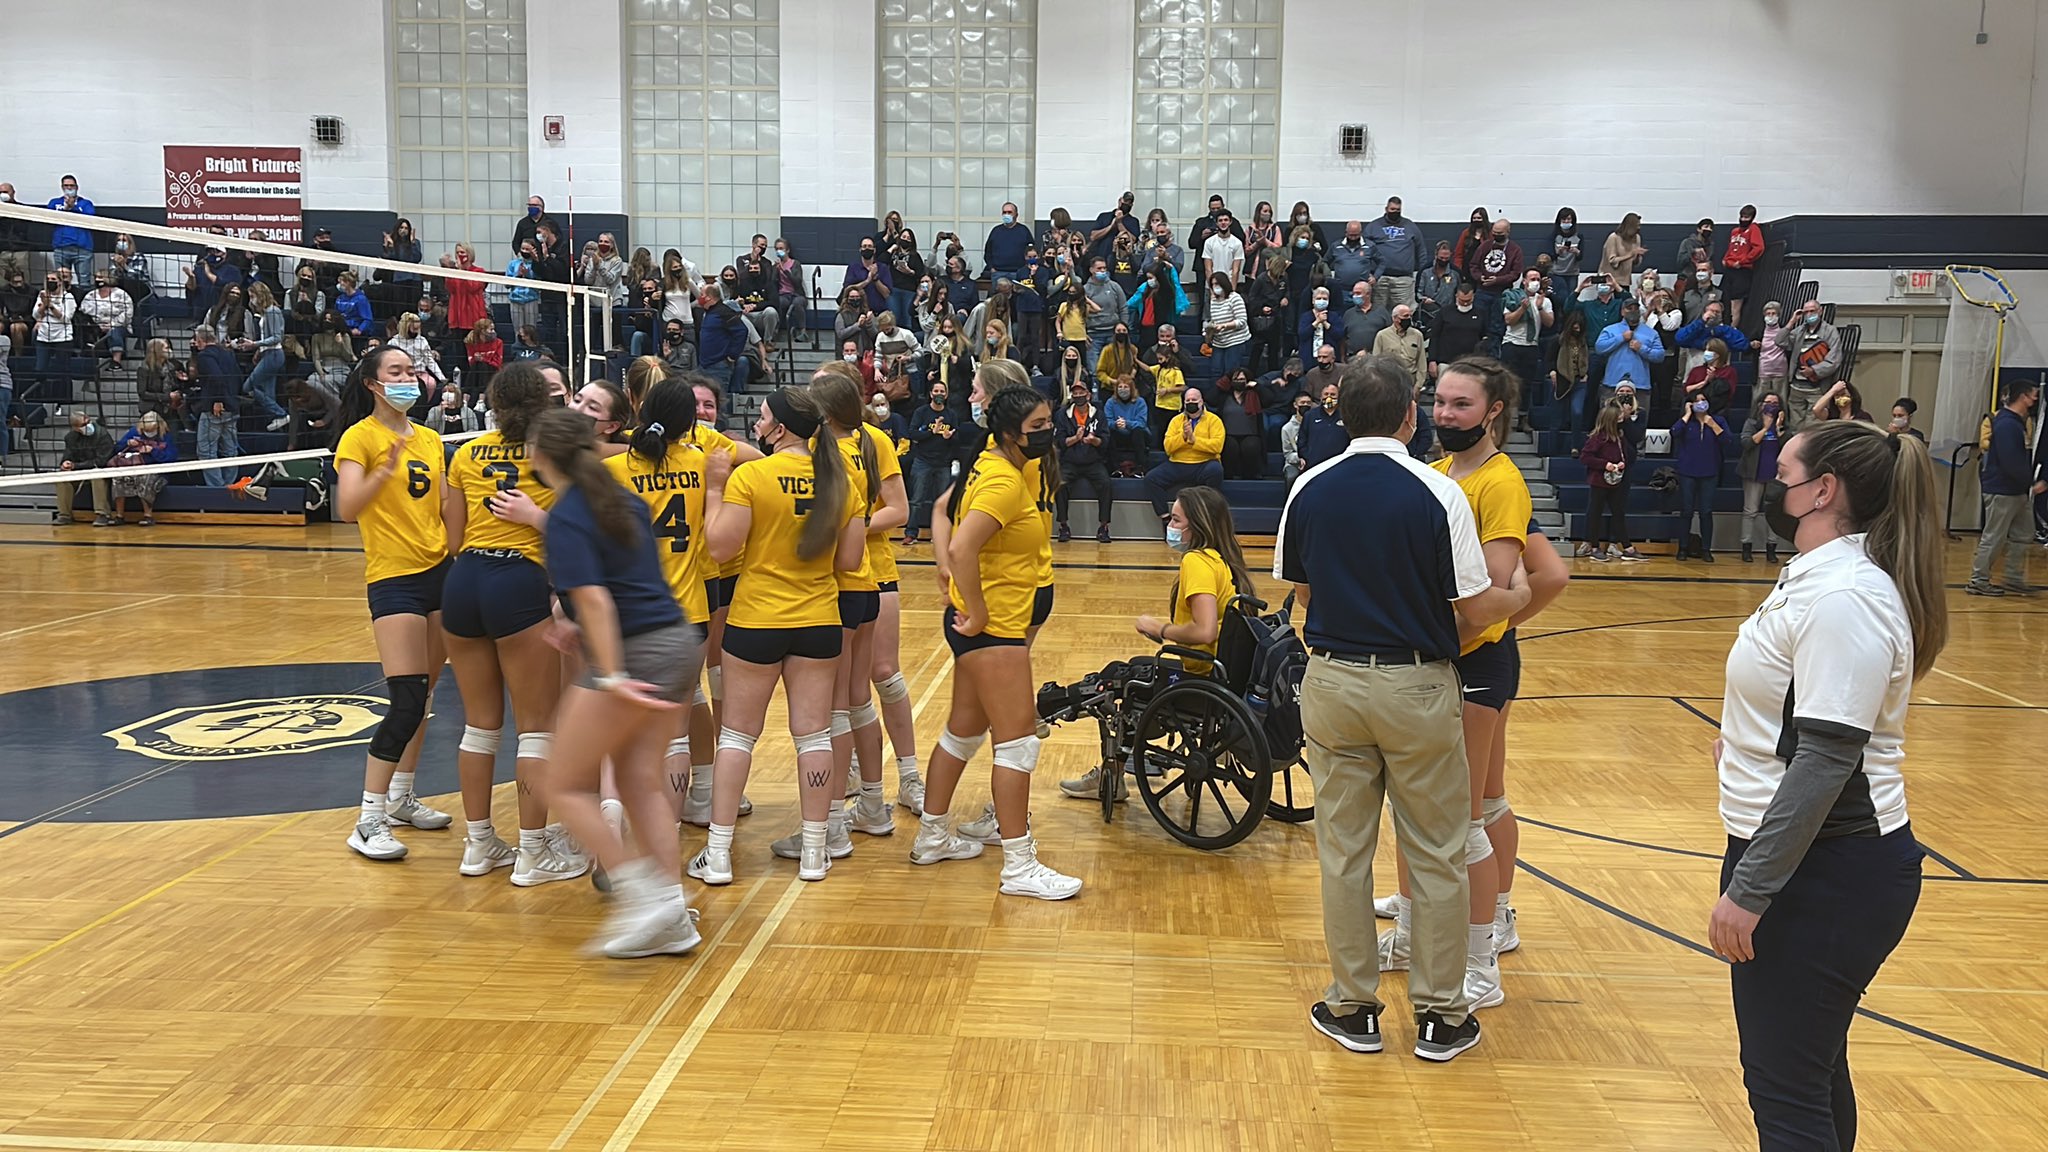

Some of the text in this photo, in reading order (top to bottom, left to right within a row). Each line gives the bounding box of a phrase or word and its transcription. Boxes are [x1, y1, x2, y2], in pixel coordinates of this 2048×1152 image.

[205, 157, 300, 174] Bright Futures
[206, 185, 228, 194] Sports
[229, 186, 261, 194] Medicine
[262, 186, 271, 194] for
[172, 212, 197, 221] Program
[204, 213, 232, 221] Character
[1912, 272, 1933, 287] EXIT
[471, 443, 530, 461] VICTO
[407, 459, 431, 499] 6
[482, 461, 520, 515] 3
[630, 470, 700, 494] VICTOR
[651, 493, 691, 553] 4
